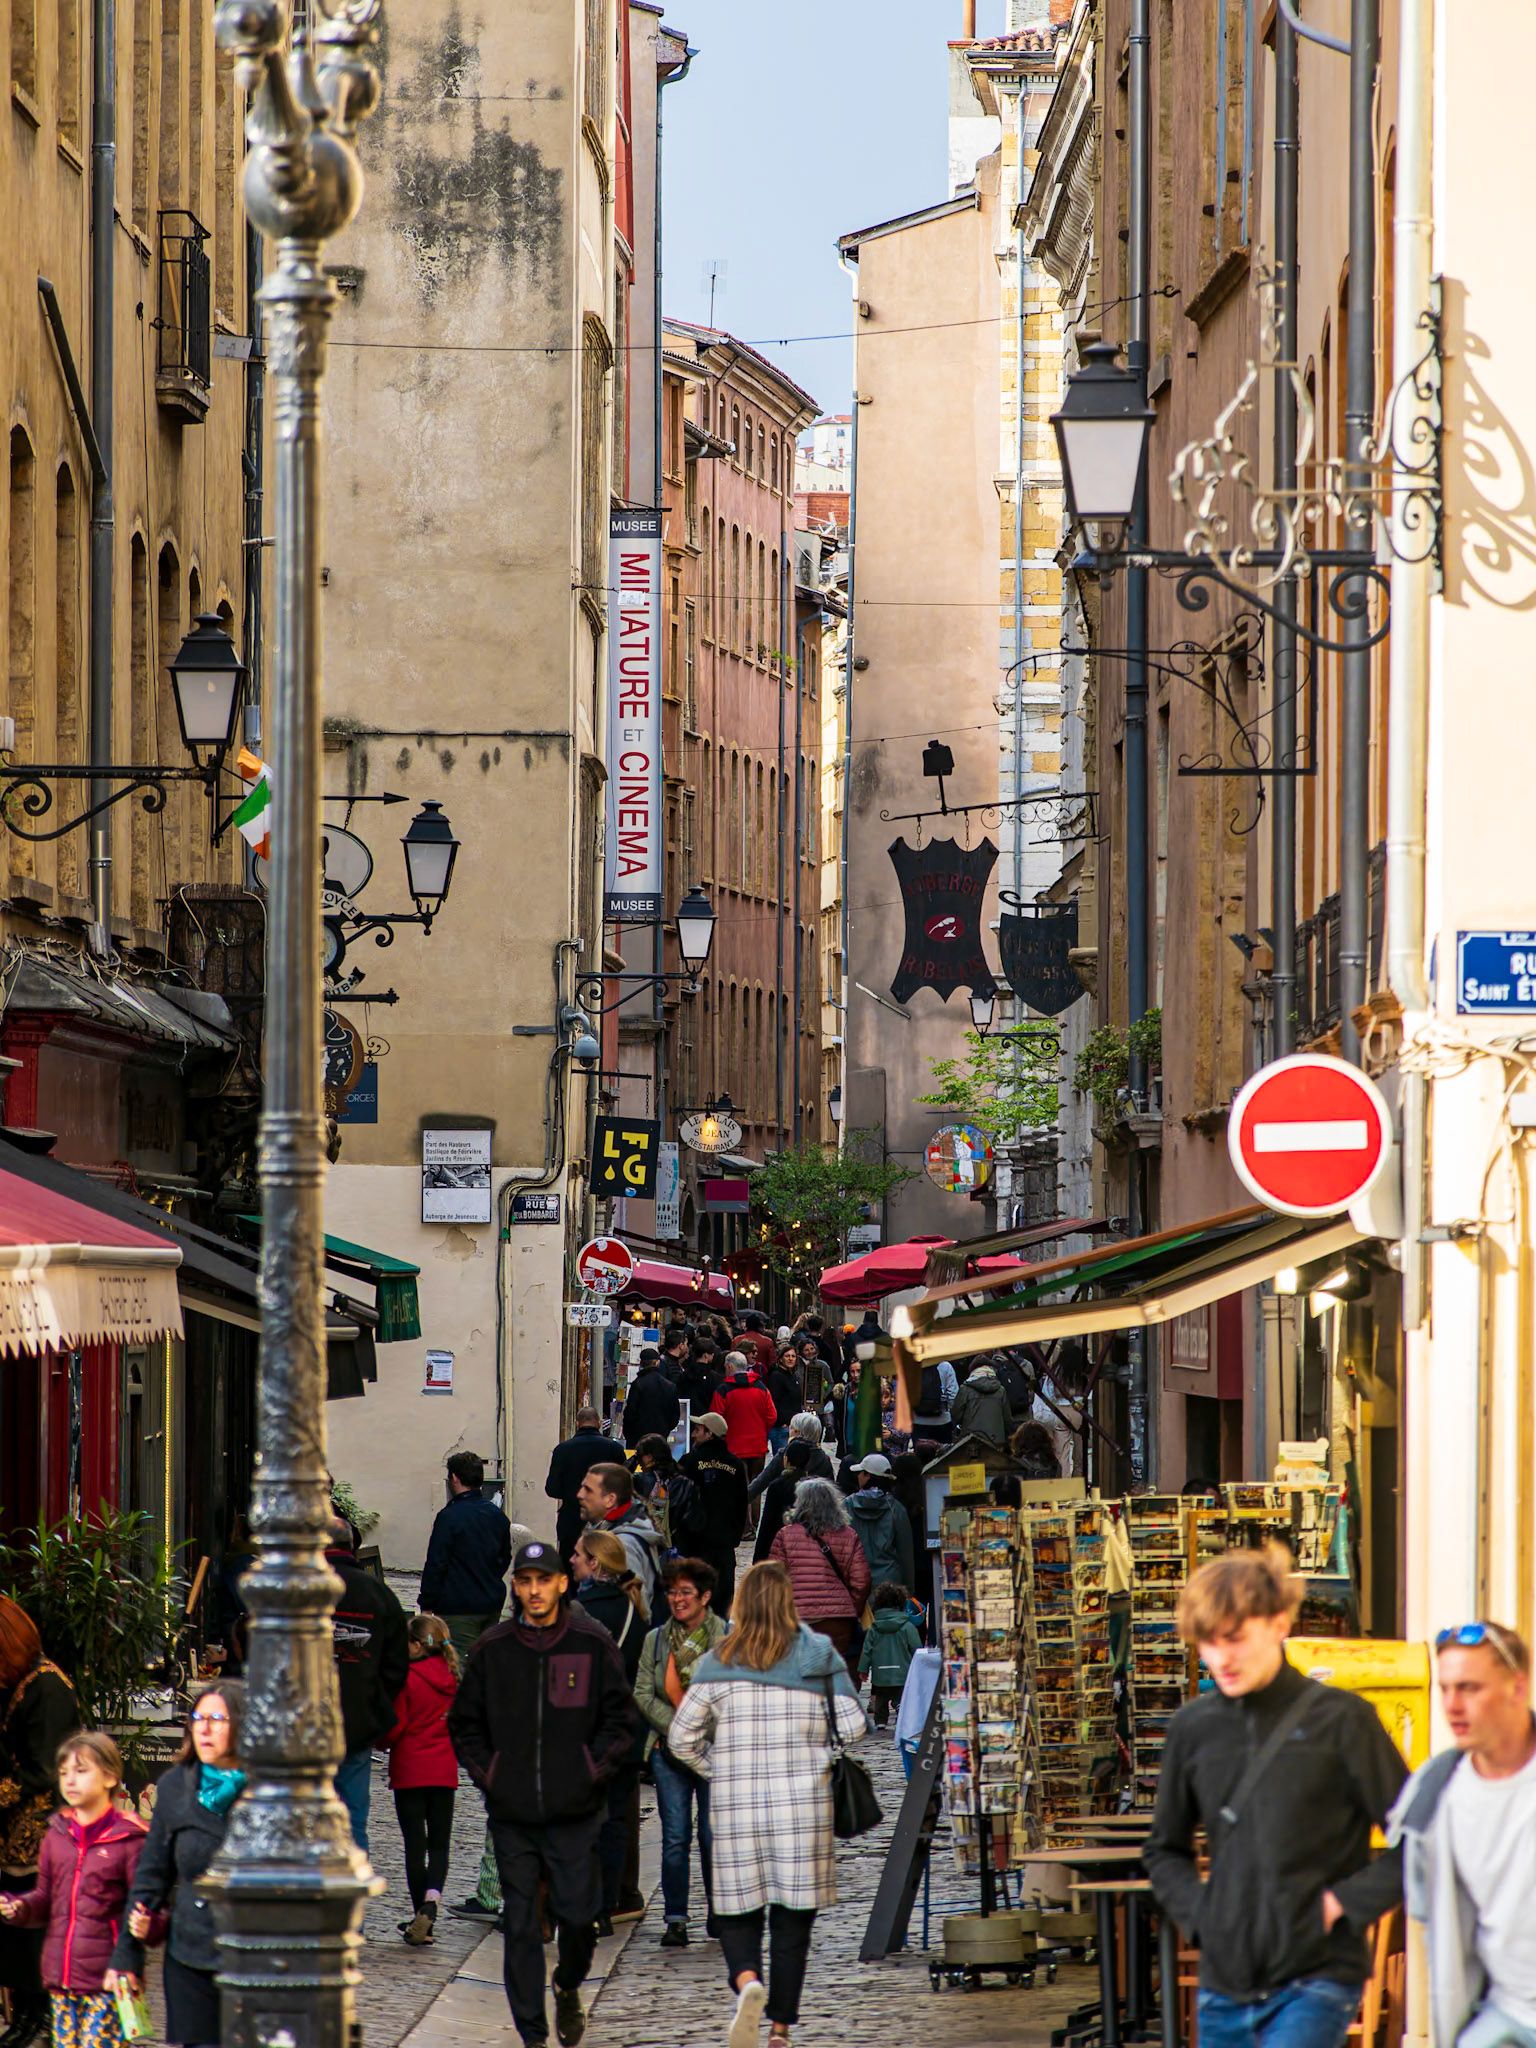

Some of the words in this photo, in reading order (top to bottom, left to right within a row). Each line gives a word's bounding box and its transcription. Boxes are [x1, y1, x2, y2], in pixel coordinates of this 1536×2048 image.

[611, 520, 657, 532] MUSEE
[623, 728, 645, 742] ET
[618, 752, 649, 878] CINEMA
[323, 892, 358, 917] OYCE
[610, 899, 655, 911] MUSEE
[687, 1116, 701, 1127] LE
[688, 1138, 735, 1152] RESTAURANT
[425, 1148, 450, 1156] Basilique
[525, 1201, 545, 1209] RUE
[425, 1213, 446, 1221] Auberge
[523, 1210, 558, 1219] BOMBARDE
